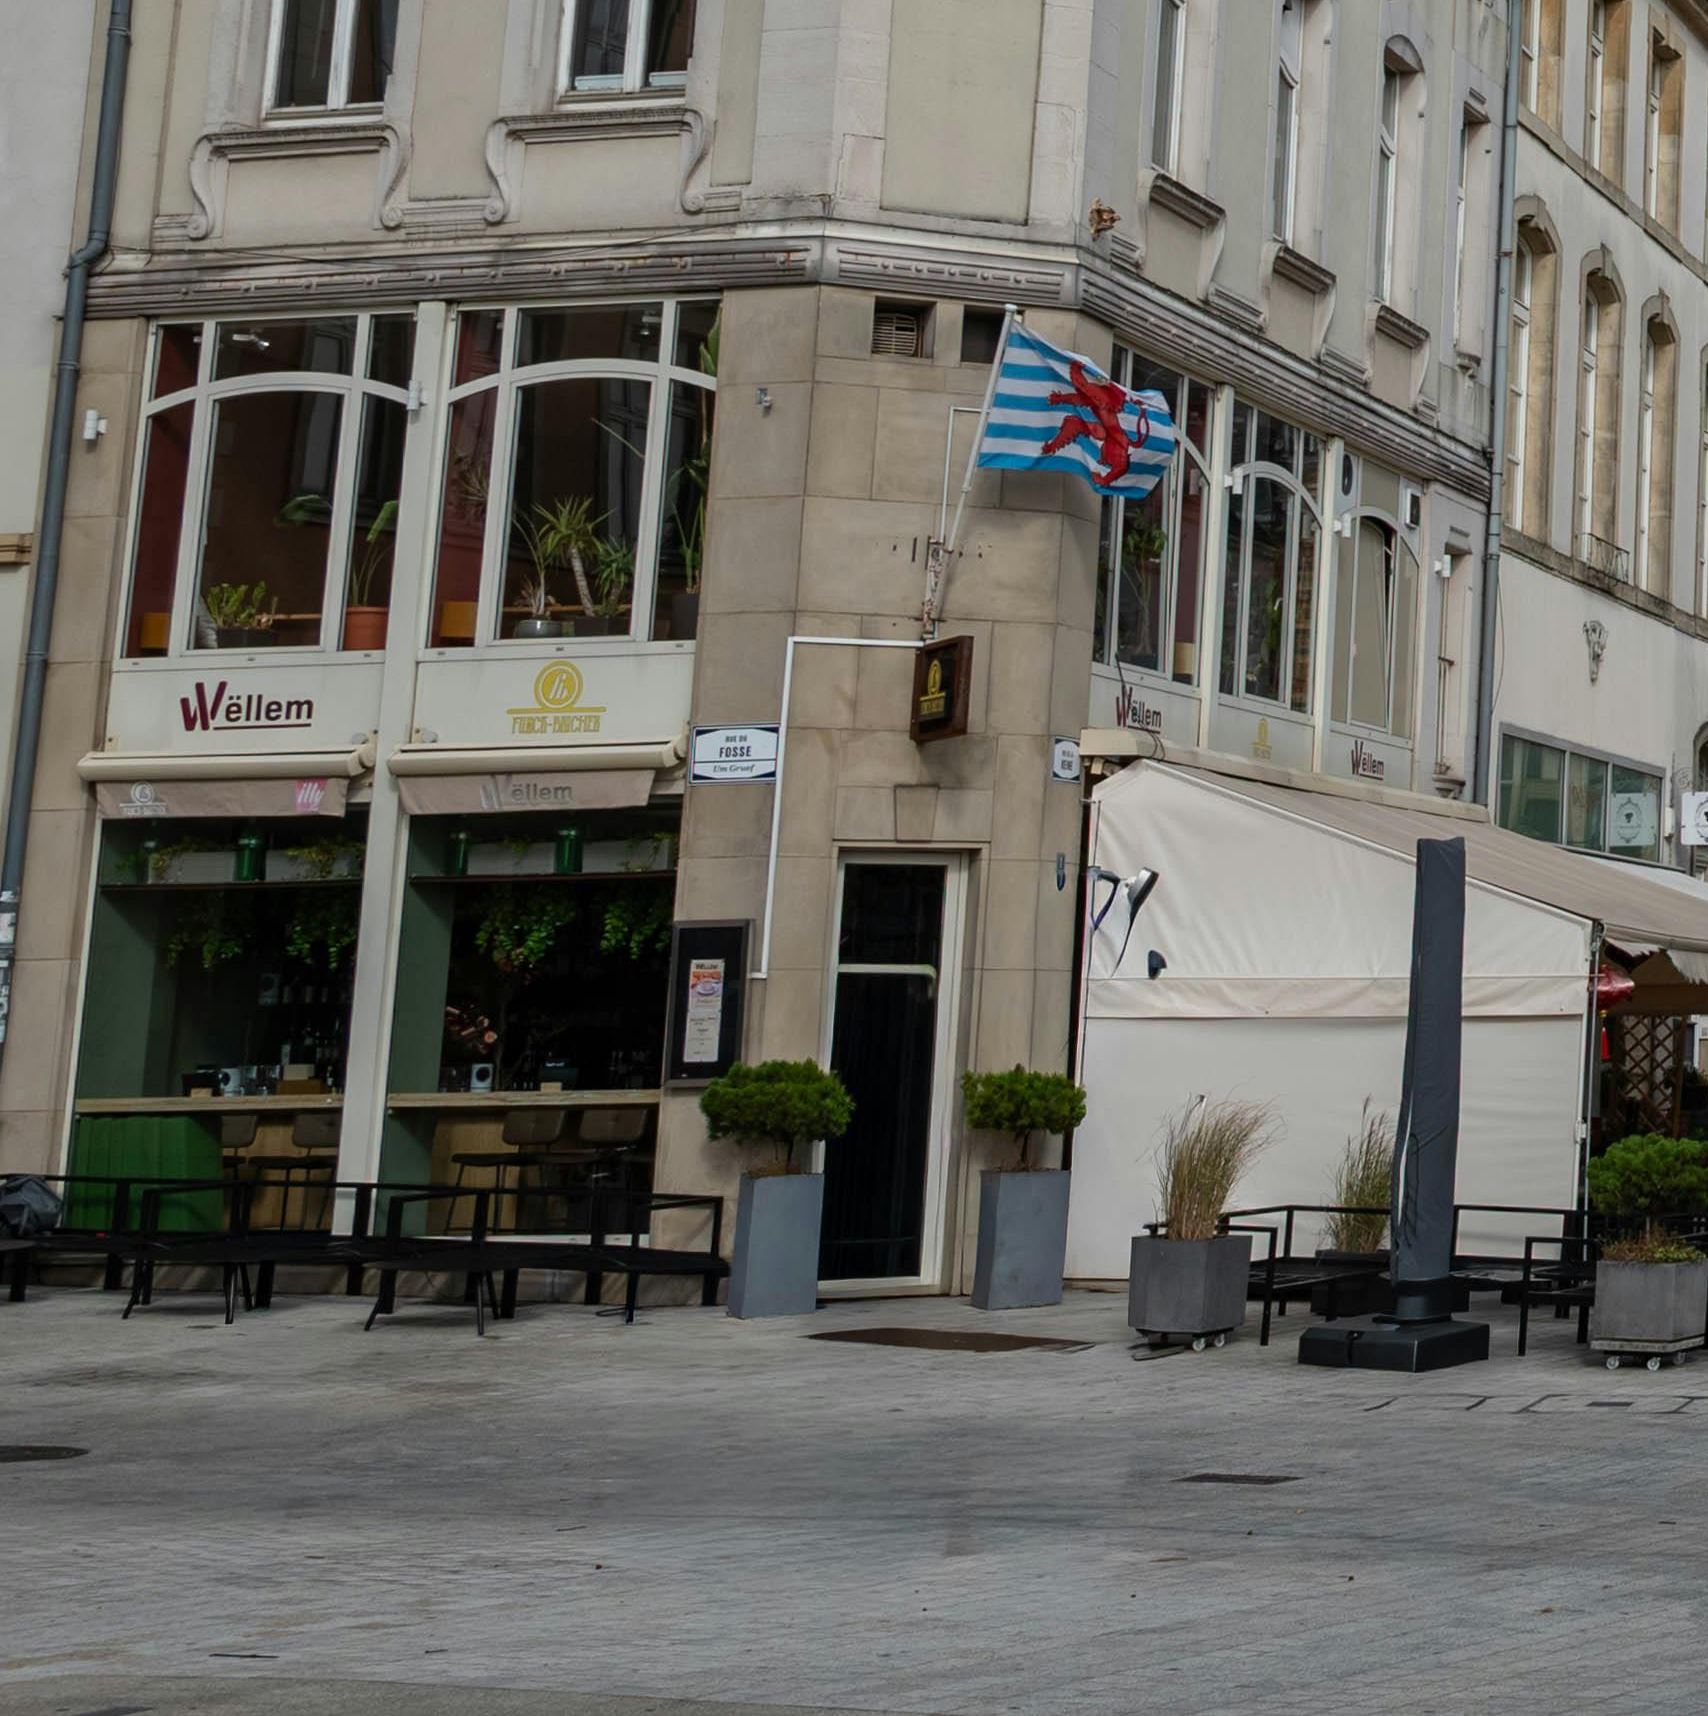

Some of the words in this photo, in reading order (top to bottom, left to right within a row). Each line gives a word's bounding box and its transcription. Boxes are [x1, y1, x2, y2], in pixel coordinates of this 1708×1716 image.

[180, 681, 314, 731] Wëllem
[1116, 685, 1162, 728] Wëllem
[725, 735, 737, 743] RUE
[1351, 739, 1384, 776] Wëllem
[298, 782, 325, 805] illy
